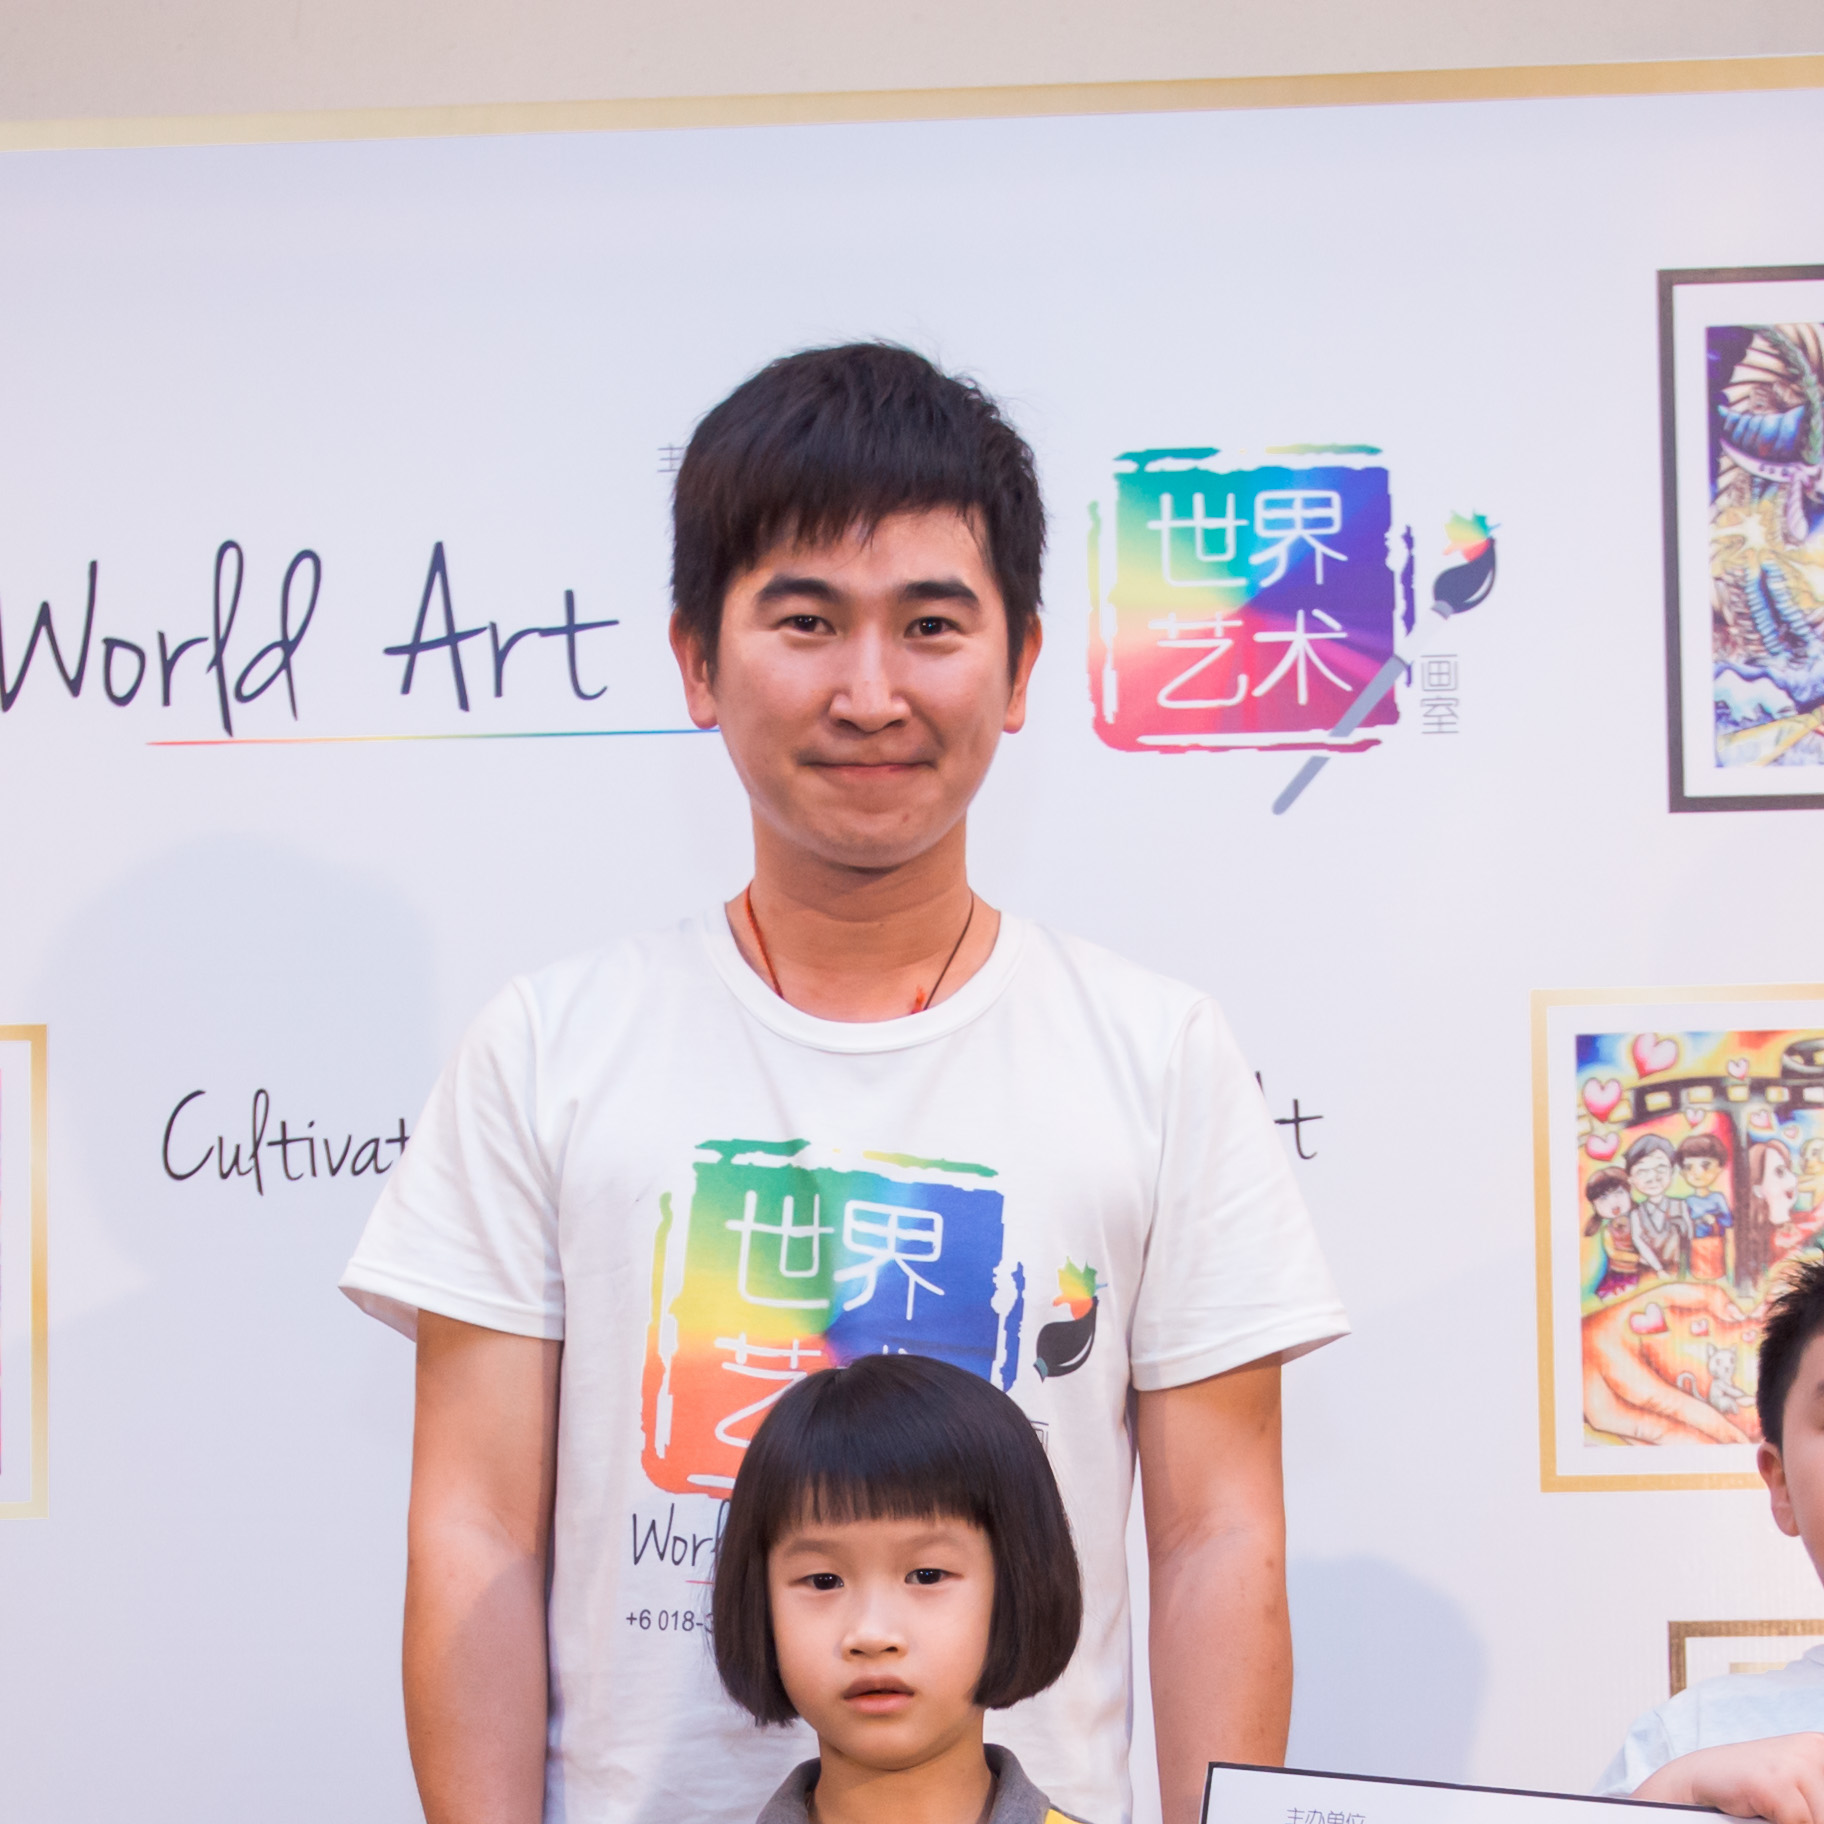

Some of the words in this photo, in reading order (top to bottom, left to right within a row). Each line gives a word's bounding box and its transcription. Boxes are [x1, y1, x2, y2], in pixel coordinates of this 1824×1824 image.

[1147, 490, 1348, 587] 世界
[385, 539, 618, 710] Art
[1148, 608, 1353, 708] 艺术
[1420, 654, 1459, 734] 画室
[726, 1190, 945, 1320] 世界
[633, 1498, 730, 1570] Worl
[626, 1609, 651, 1630] +6
